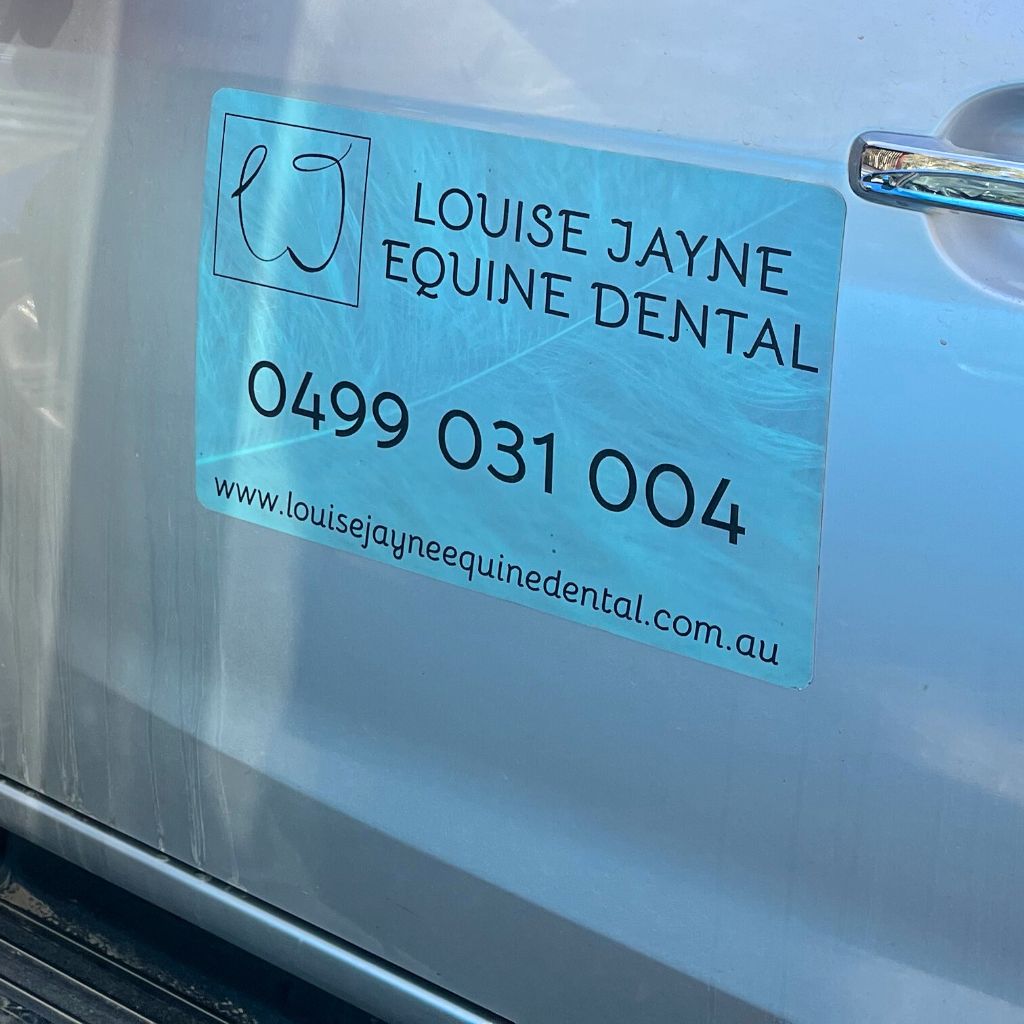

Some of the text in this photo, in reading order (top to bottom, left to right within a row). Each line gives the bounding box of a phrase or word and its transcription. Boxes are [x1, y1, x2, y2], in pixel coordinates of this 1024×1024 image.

[381, 239, 819, 374] EQUINE DENTAL
[414, 181, 792, 296] LOUISE JAYNE
[248, 360, 746, 546] 0499 031 004
[214, 476, 779, 666] www.louisejayneequinedental.com.au
